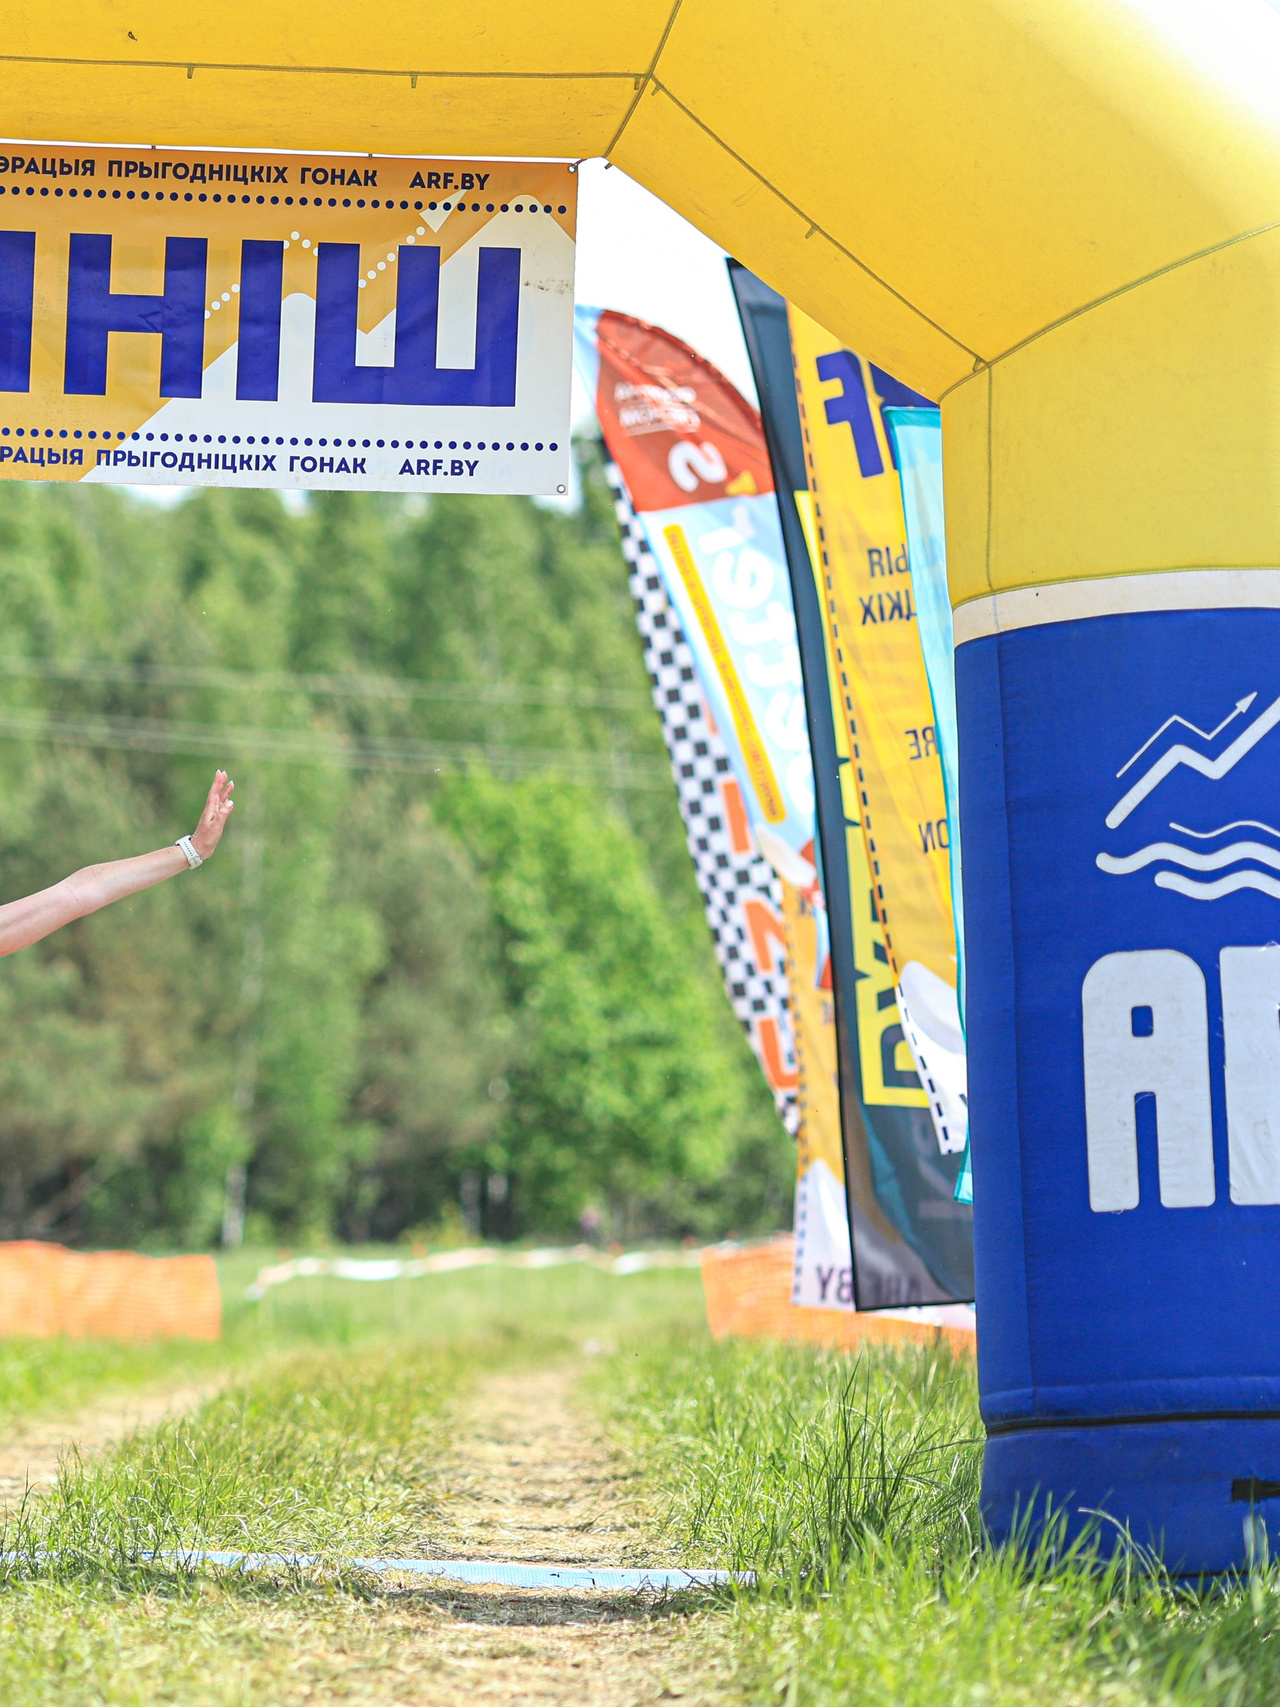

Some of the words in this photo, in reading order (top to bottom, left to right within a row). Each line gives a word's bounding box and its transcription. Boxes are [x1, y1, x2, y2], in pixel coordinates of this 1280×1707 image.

[107, 159, 289, 185] ПРЫГОДНІЦКІХ
[300, 167, 378, 188] ГОНАК
[409, 171, 490, 191] ARF.BY
[96, 449, 277, 474] ПРЫГОДНІЦКІХ
[289, 455, 367, 475] ГОНАК
[398, 458, 480, 478] ARF.BY
